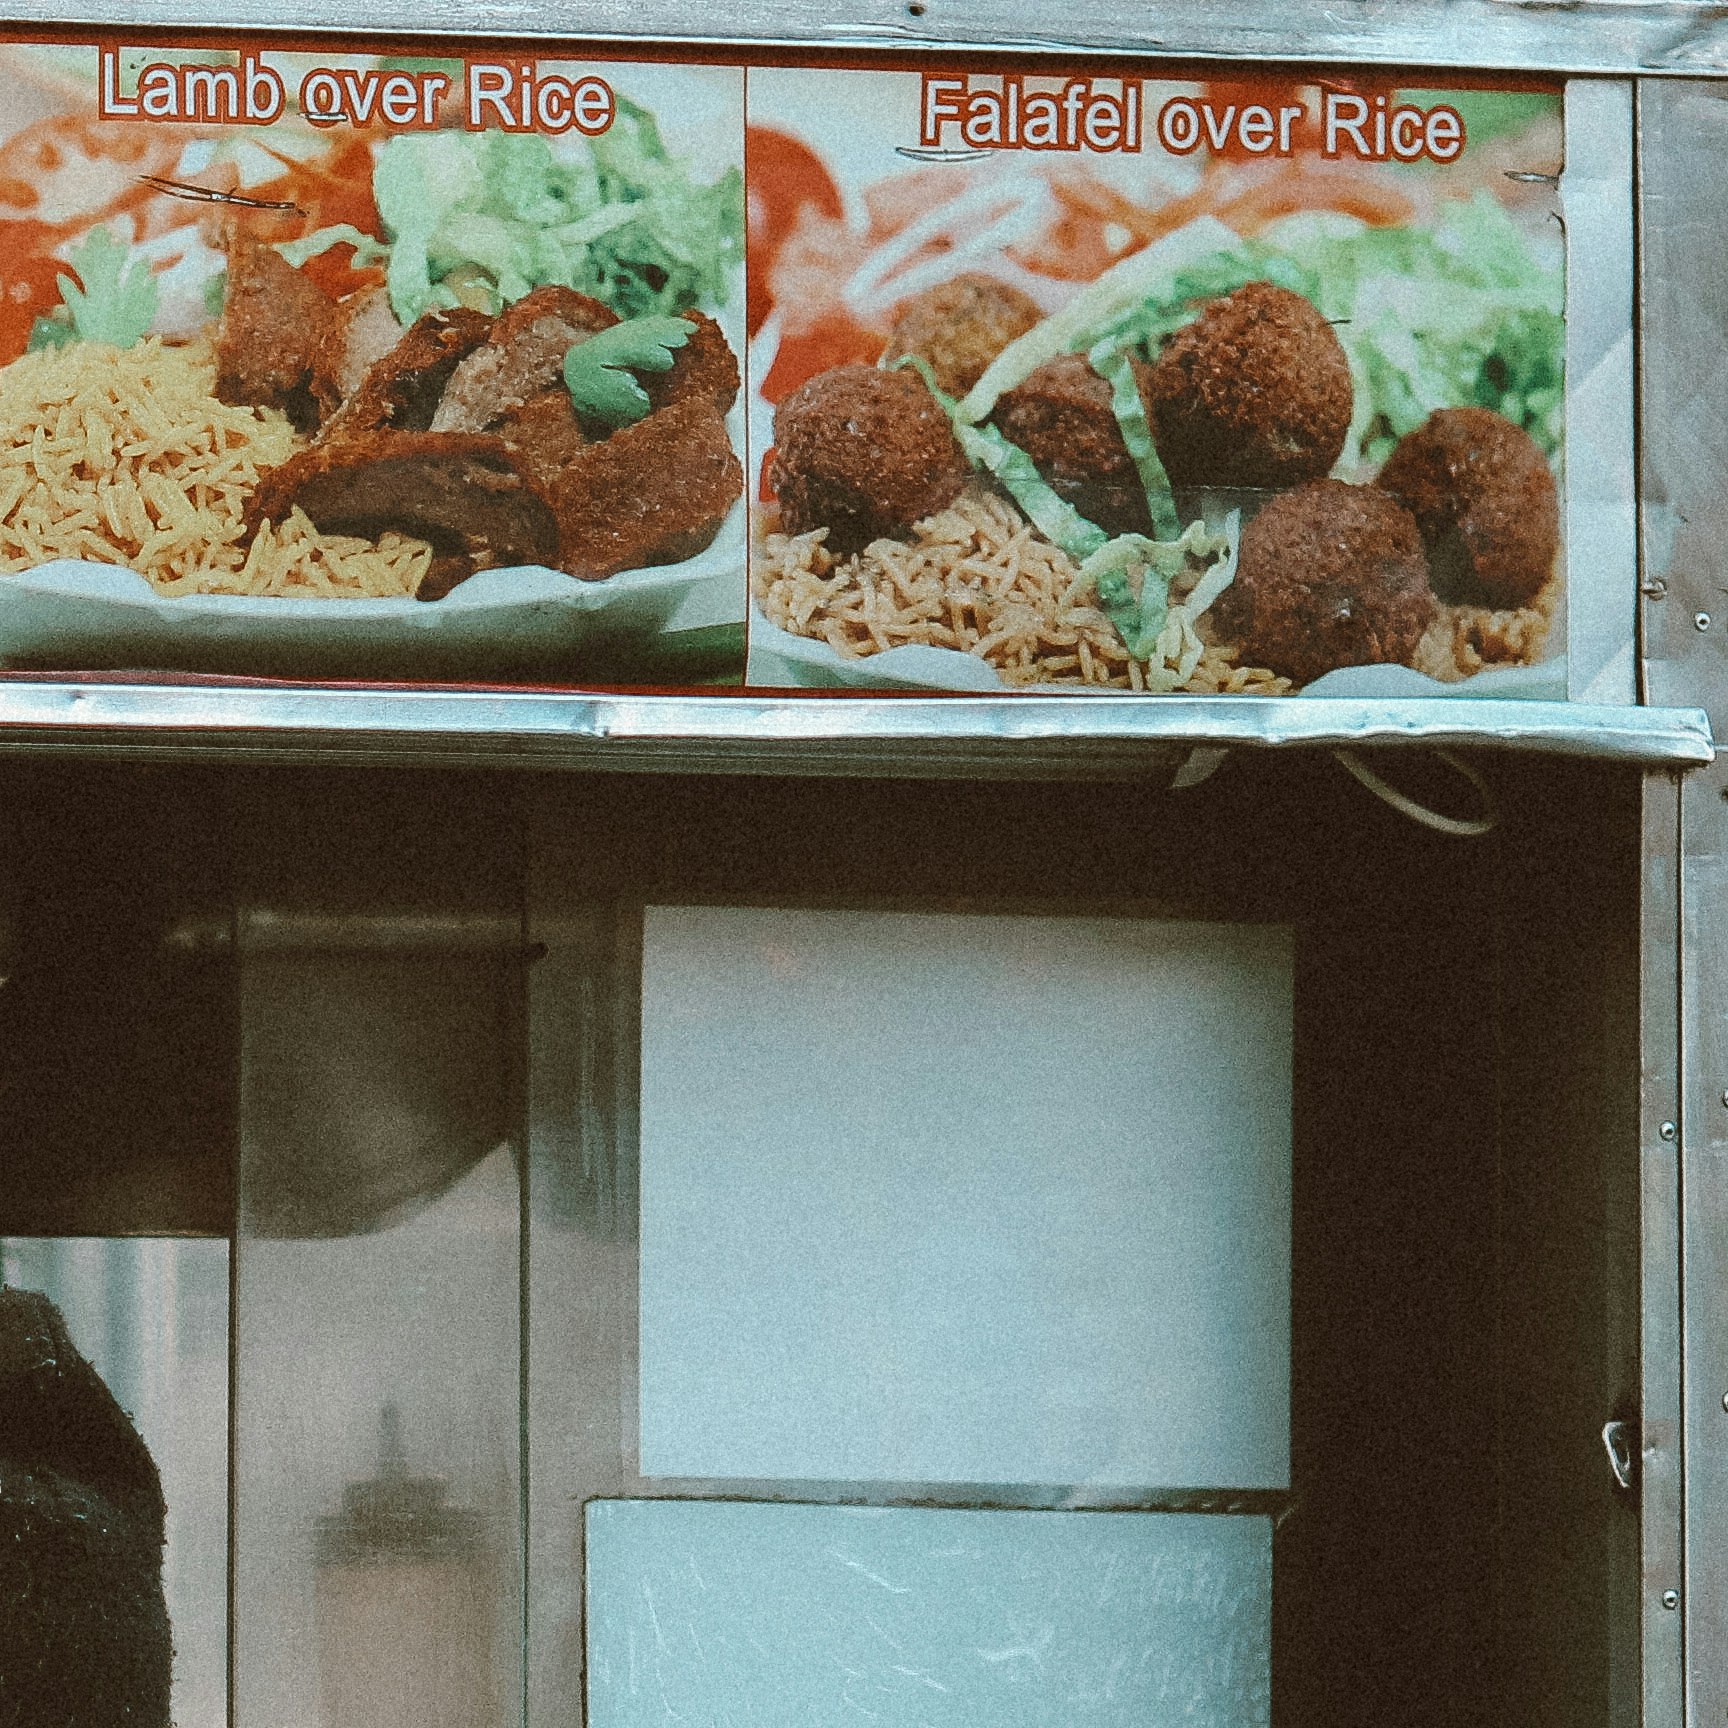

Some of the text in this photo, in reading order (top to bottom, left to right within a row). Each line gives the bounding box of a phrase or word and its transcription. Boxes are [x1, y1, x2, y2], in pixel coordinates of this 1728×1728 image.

[102, 51, 613, 130] Lamb over Rice
[924, 78, 1462, 159] Falafel over Rice
